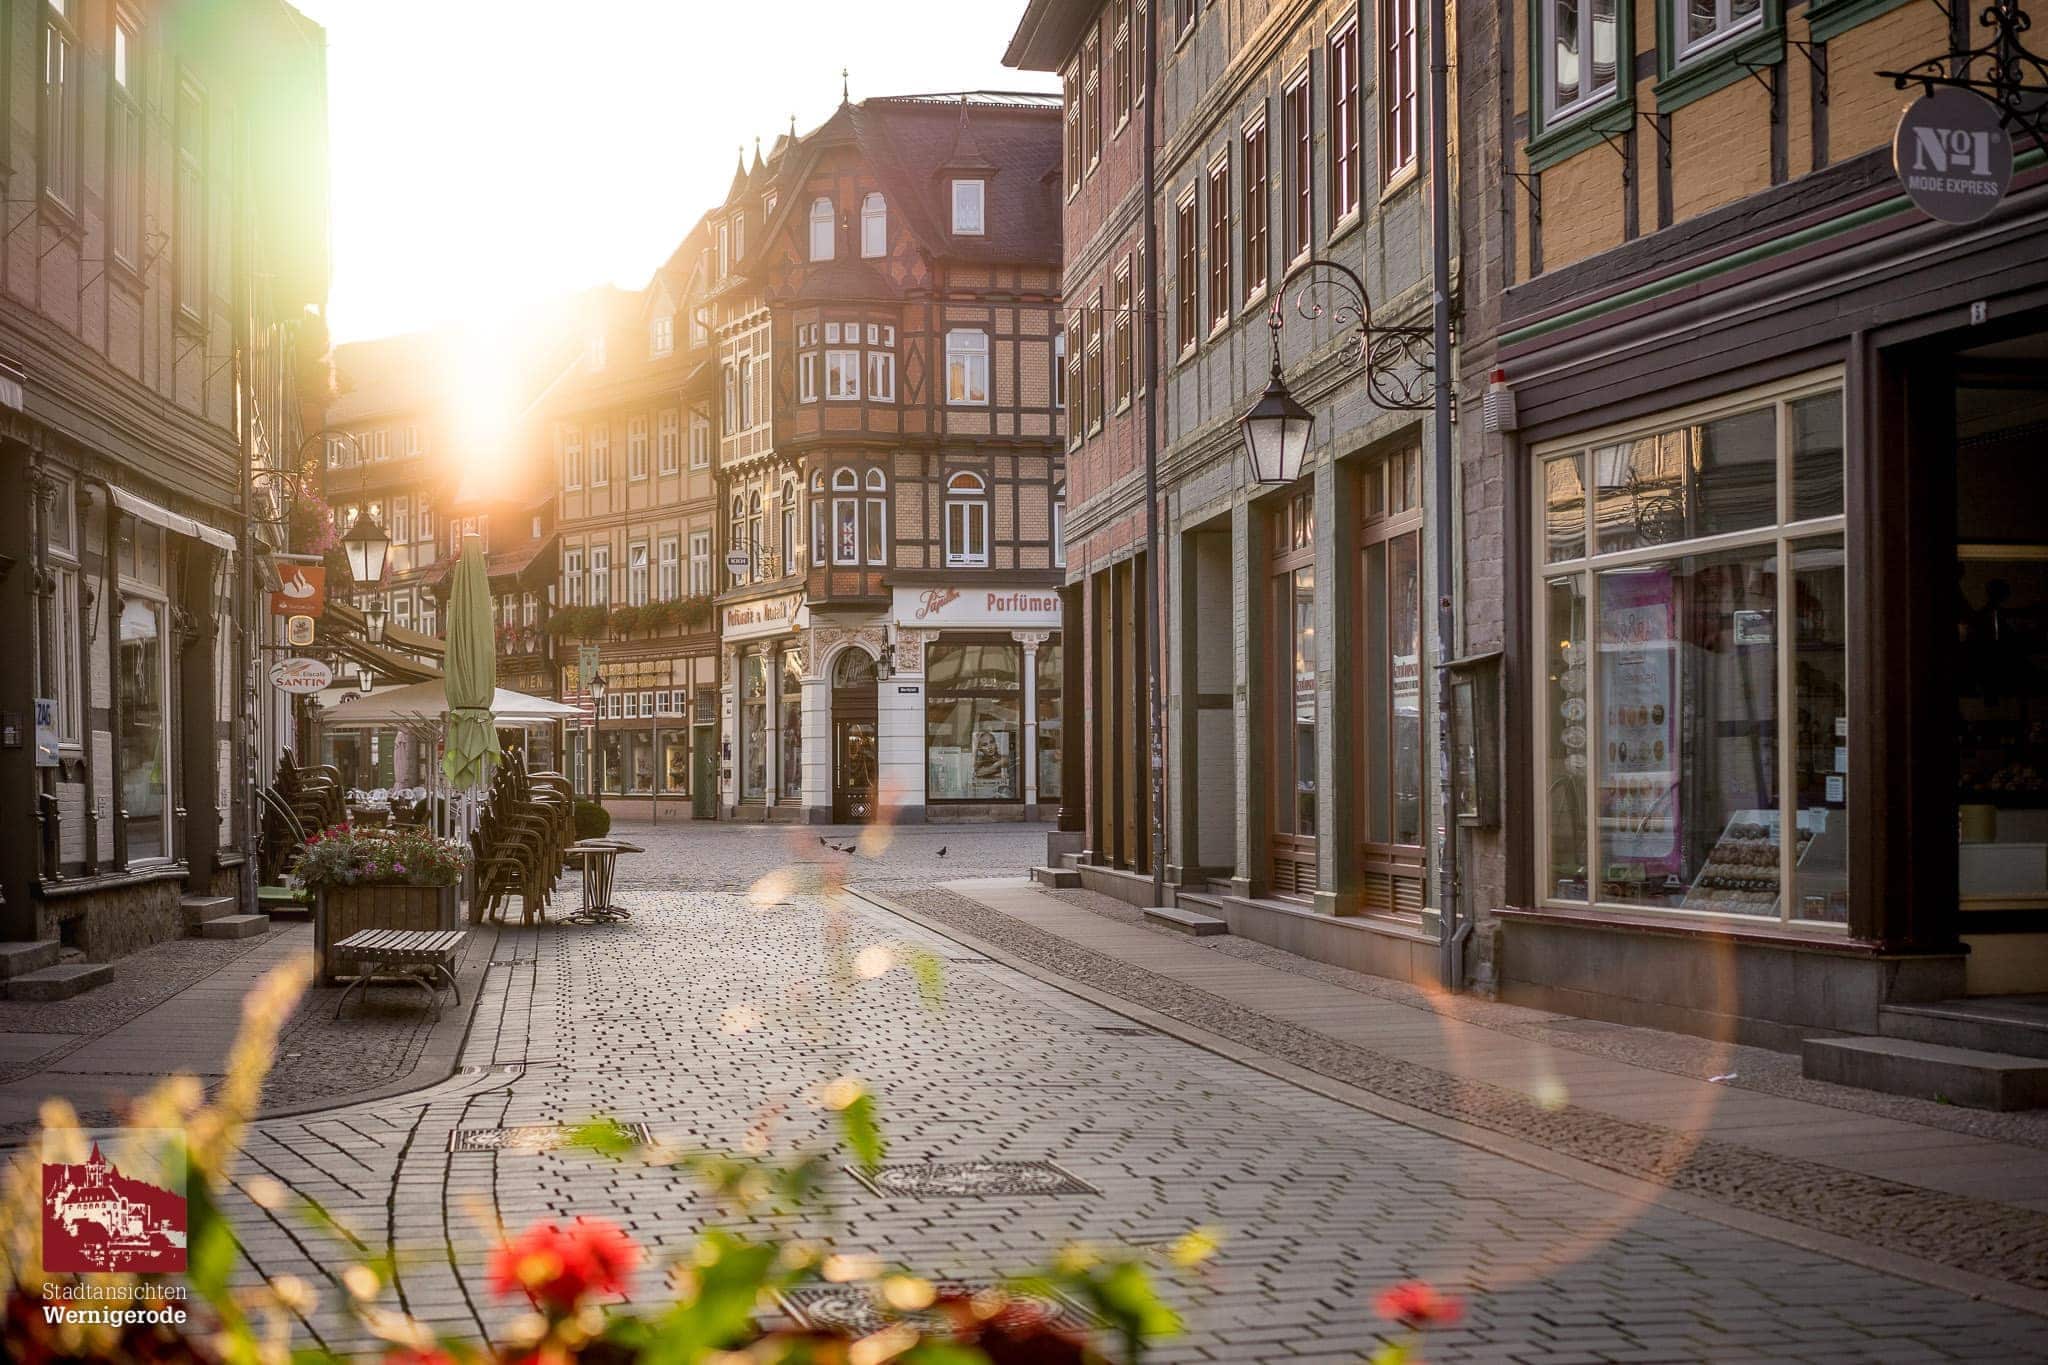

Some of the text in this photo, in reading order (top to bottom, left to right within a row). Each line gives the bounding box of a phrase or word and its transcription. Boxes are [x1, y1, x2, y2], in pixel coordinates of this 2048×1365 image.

[1909, 175, 1999, 196] MODE EXPRESS
[276, 677, 326, 687] SANTIN
[519, 673, 544, 689] WIEN
[37, 703, 51, 726] ZAG
